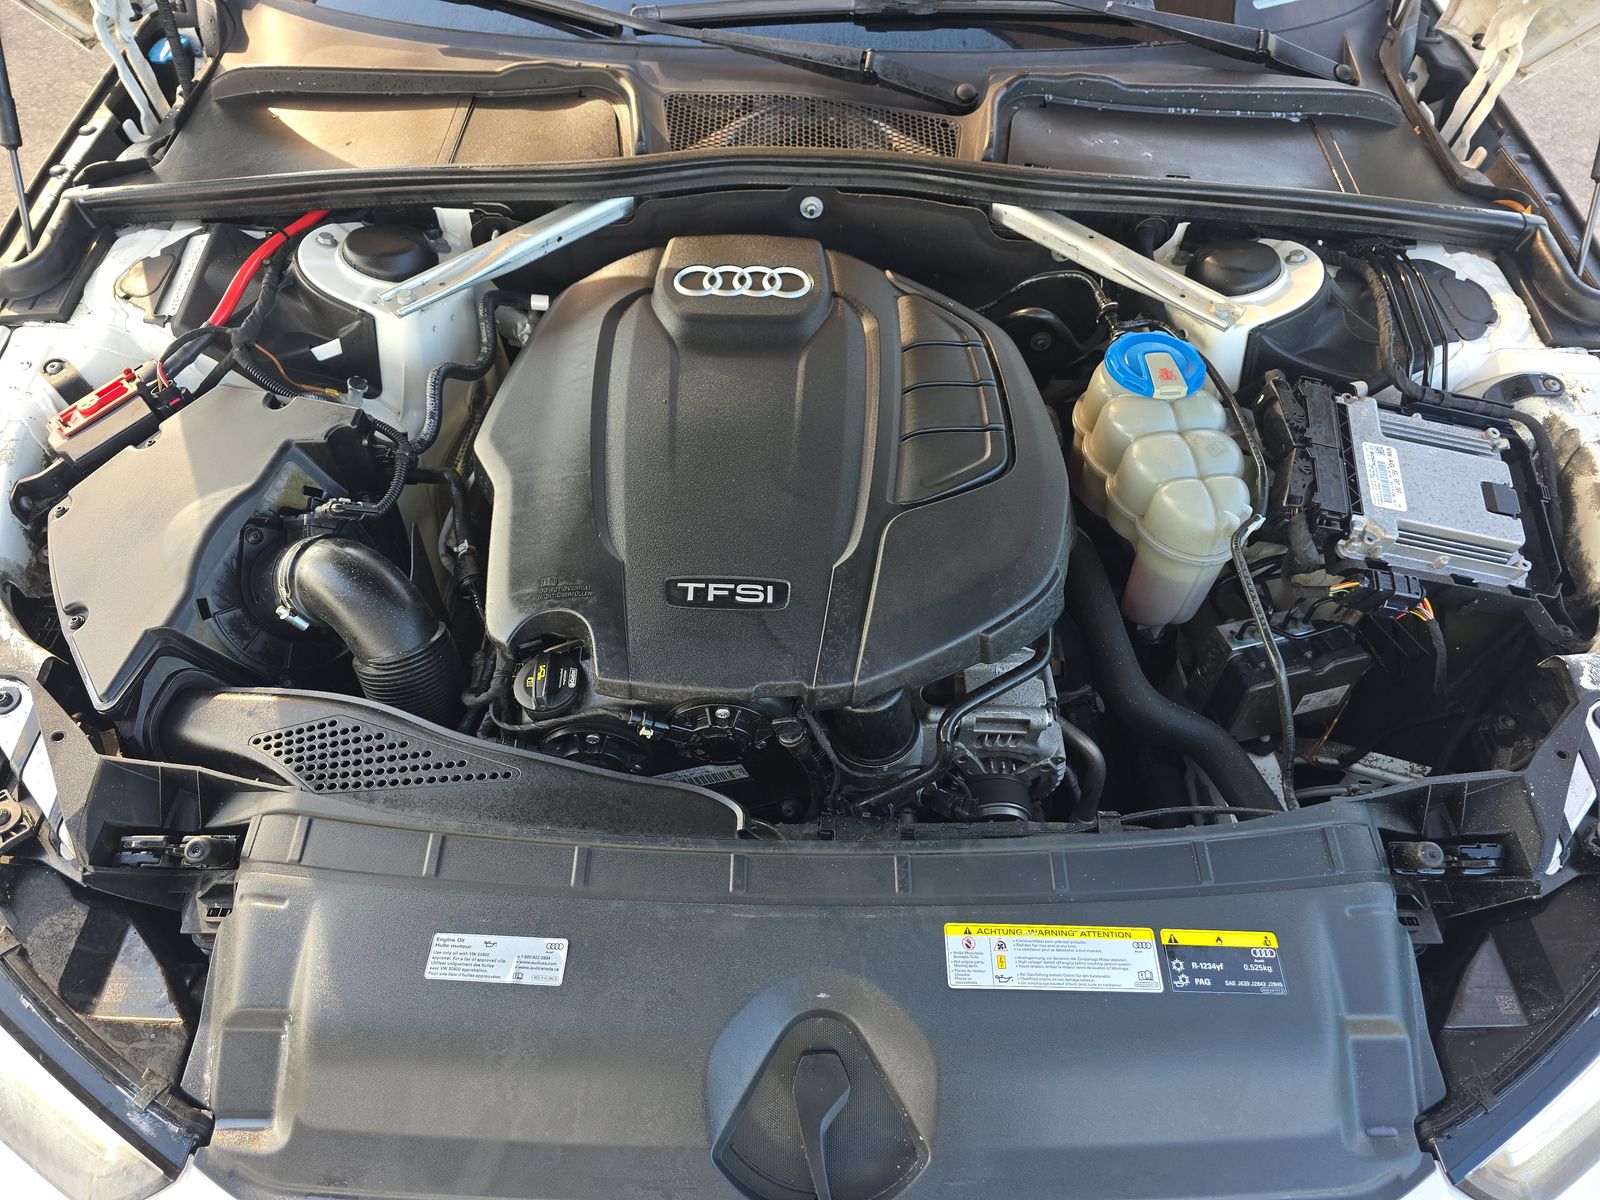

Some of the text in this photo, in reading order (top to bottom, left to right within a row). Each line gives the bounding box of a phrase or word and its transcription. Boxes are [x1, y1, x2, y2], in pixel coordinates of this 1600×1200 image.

[677, 582, 773, 604] TFSI
[1192, 962, 1272, 972] R-1234yf 0.525kg
